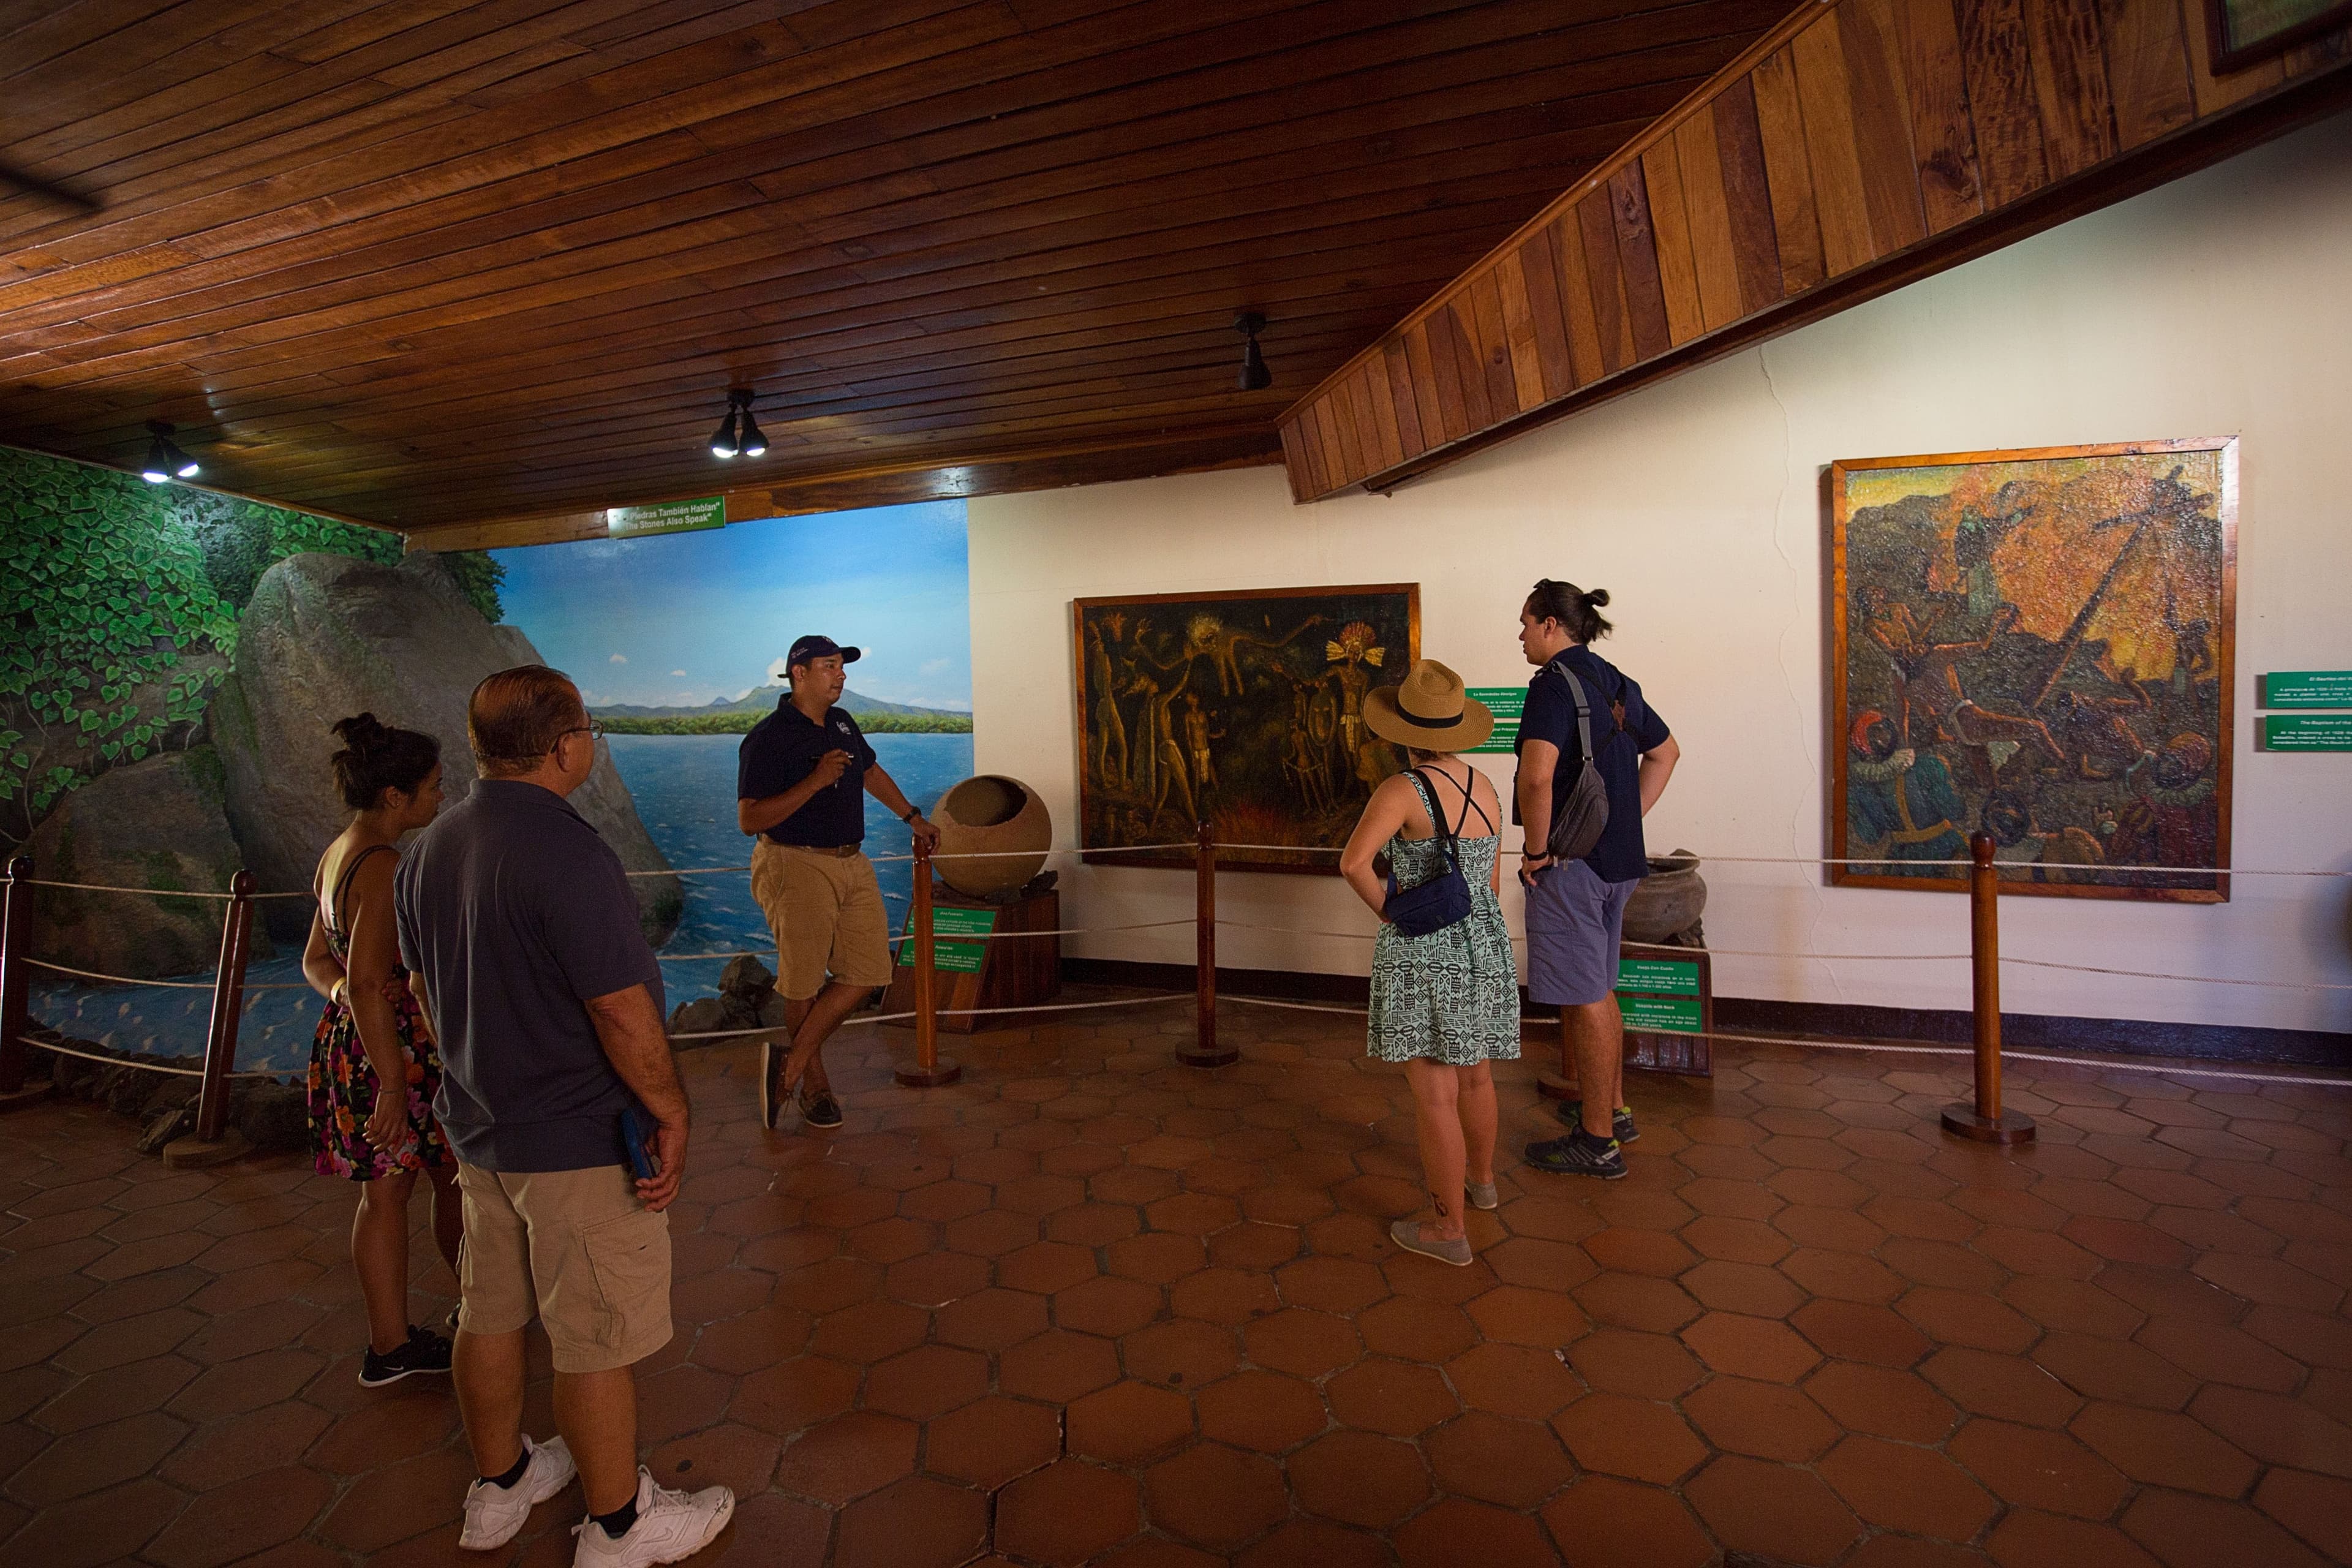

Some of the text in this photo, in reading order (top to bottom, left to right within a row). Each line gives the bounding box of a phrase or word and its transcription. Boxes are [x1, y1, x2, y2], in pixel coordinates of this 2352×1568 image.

[630, 510, 657, 520] Piedras
[658, 506, 689, 518] También
[639, 519, 665, 529] Stones
[666, 517, 684, 526] Also
